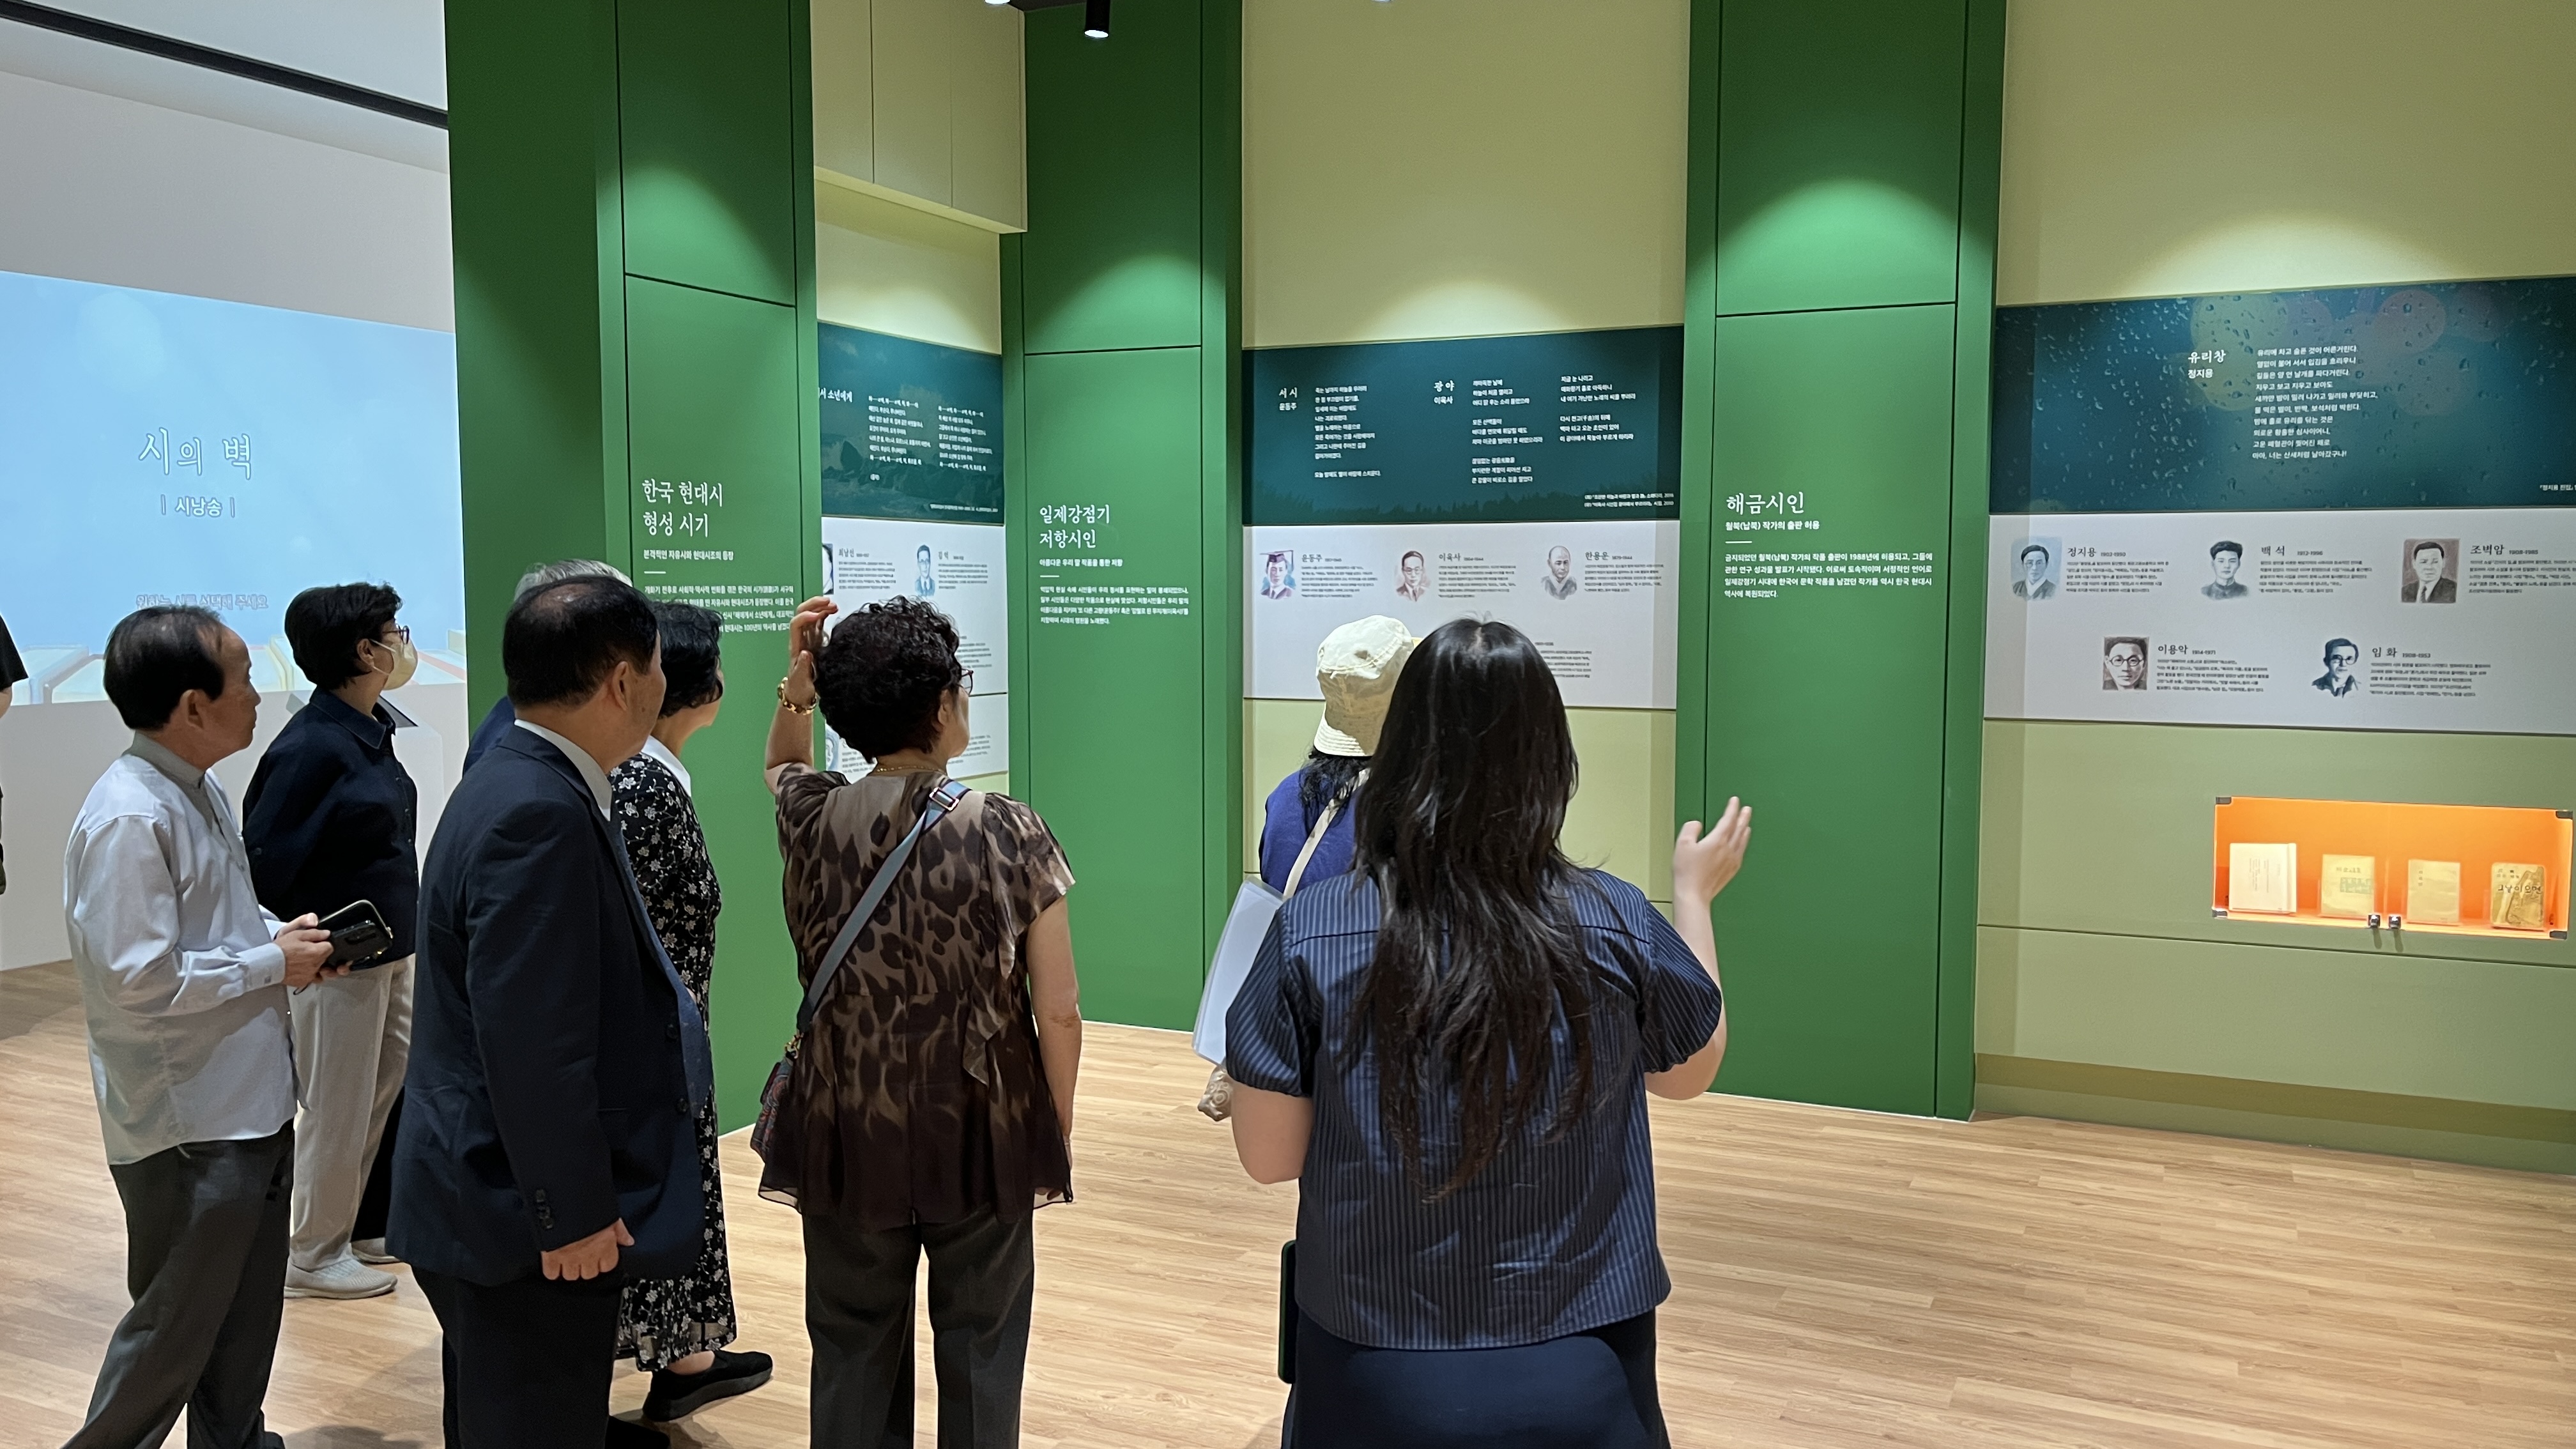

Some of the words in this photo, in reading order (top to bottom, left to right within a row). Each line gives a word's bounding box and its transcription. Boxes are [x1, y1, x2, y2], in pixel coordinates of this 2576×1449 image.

[2188, 350, 2226, 364] 유리창
[2188, 369, 2214, 378] 정지용
[827, 390, 852, 402] 소년에게
[1434, 396, 1453, 404] 이육사
[2276, 394, 2289, 402] 밤이
[1279, 402, 1297, 411] 윤동주
[138, 426, 204, 476] 시의
[221, 433, 253, 480] 벽
[642, 478, 673, 504] 한국
[678, 480, 723, 507] 현대시
[175, 495, 222, 518] 시낭송
[1726, 491, 1804, 515] 해금시인
[1039, 505, 1110, 524] 일제강점기
[643, 511, 673, 537] 형성
[680, 512, 709, 538] 시기
[1726, 521, 1760, 530] 월북(납북)
[1763, 521, 1785, 530] 작가의
[1787, 520, 1802, 530] 출판
[1804, 520, 1820, 529] 허용
[1039, 529, 1096, 549] 저항시인
[643, 549, 667, 559] 본격적인
[668, 550, 692, 559] 자유시와
[693, 550, 721, 560] 현대시조의
[1585, 551, 1609, 561] 한용운
[2067, 547, 2096, 557] 정지용
[2262, 546, 2271, 556] 백
[2275, 546, 2285, 556] 석
[1439, 553, 1460, 561] 이육사
[1725, 553, 1756, 562] 금지되었던
[1813, 553, 1825, 561] 작품
[1828, 553, 1847, 561] 출판이
[1850, 553, 1879, 561] 1988년에
[1883, 565, 1909, 573] 서정적인
[1912, 565, 1932, 573] 언어로
[1800, 577, 1813, 585] 문학
[235, 594, 268, 610] 주세요
[2158, 644, 2188, 655] 이용악
[2372, 647, 2382, 657] 임
[2386, 647, 2397, 658] 화
